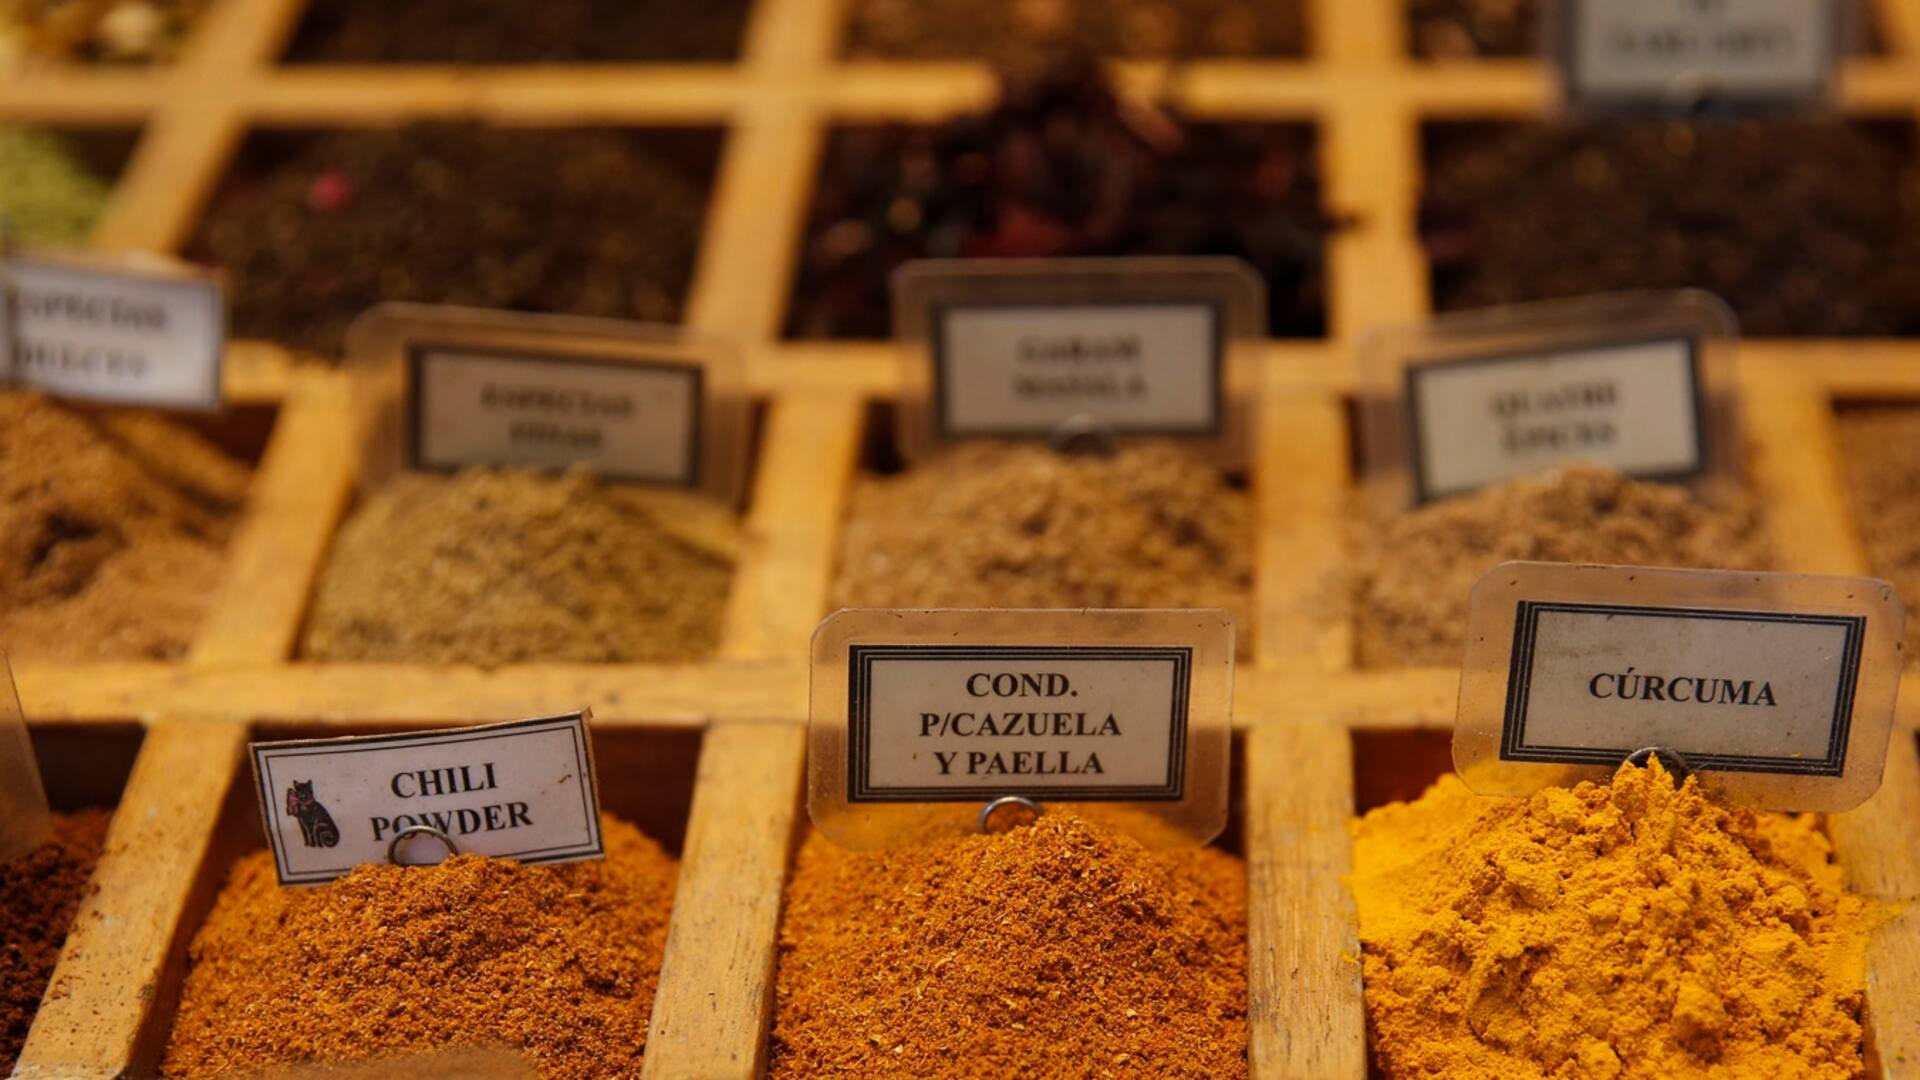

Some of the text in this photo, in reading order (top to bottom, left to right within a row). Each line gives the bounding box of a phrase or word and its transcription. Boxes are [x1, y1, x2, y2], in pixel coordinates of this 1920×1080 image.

[966, 672, 1079, 697] COND.
[1588, 667, 1777, 706] CÚRCUMA
[919, 711, 1122, 738] P/CAZUELA
[934, 751, 1105, 775] Y PAELLA
[390, 761, 498, 799] CHILI
[370, 801, 533, 842] POWDER
